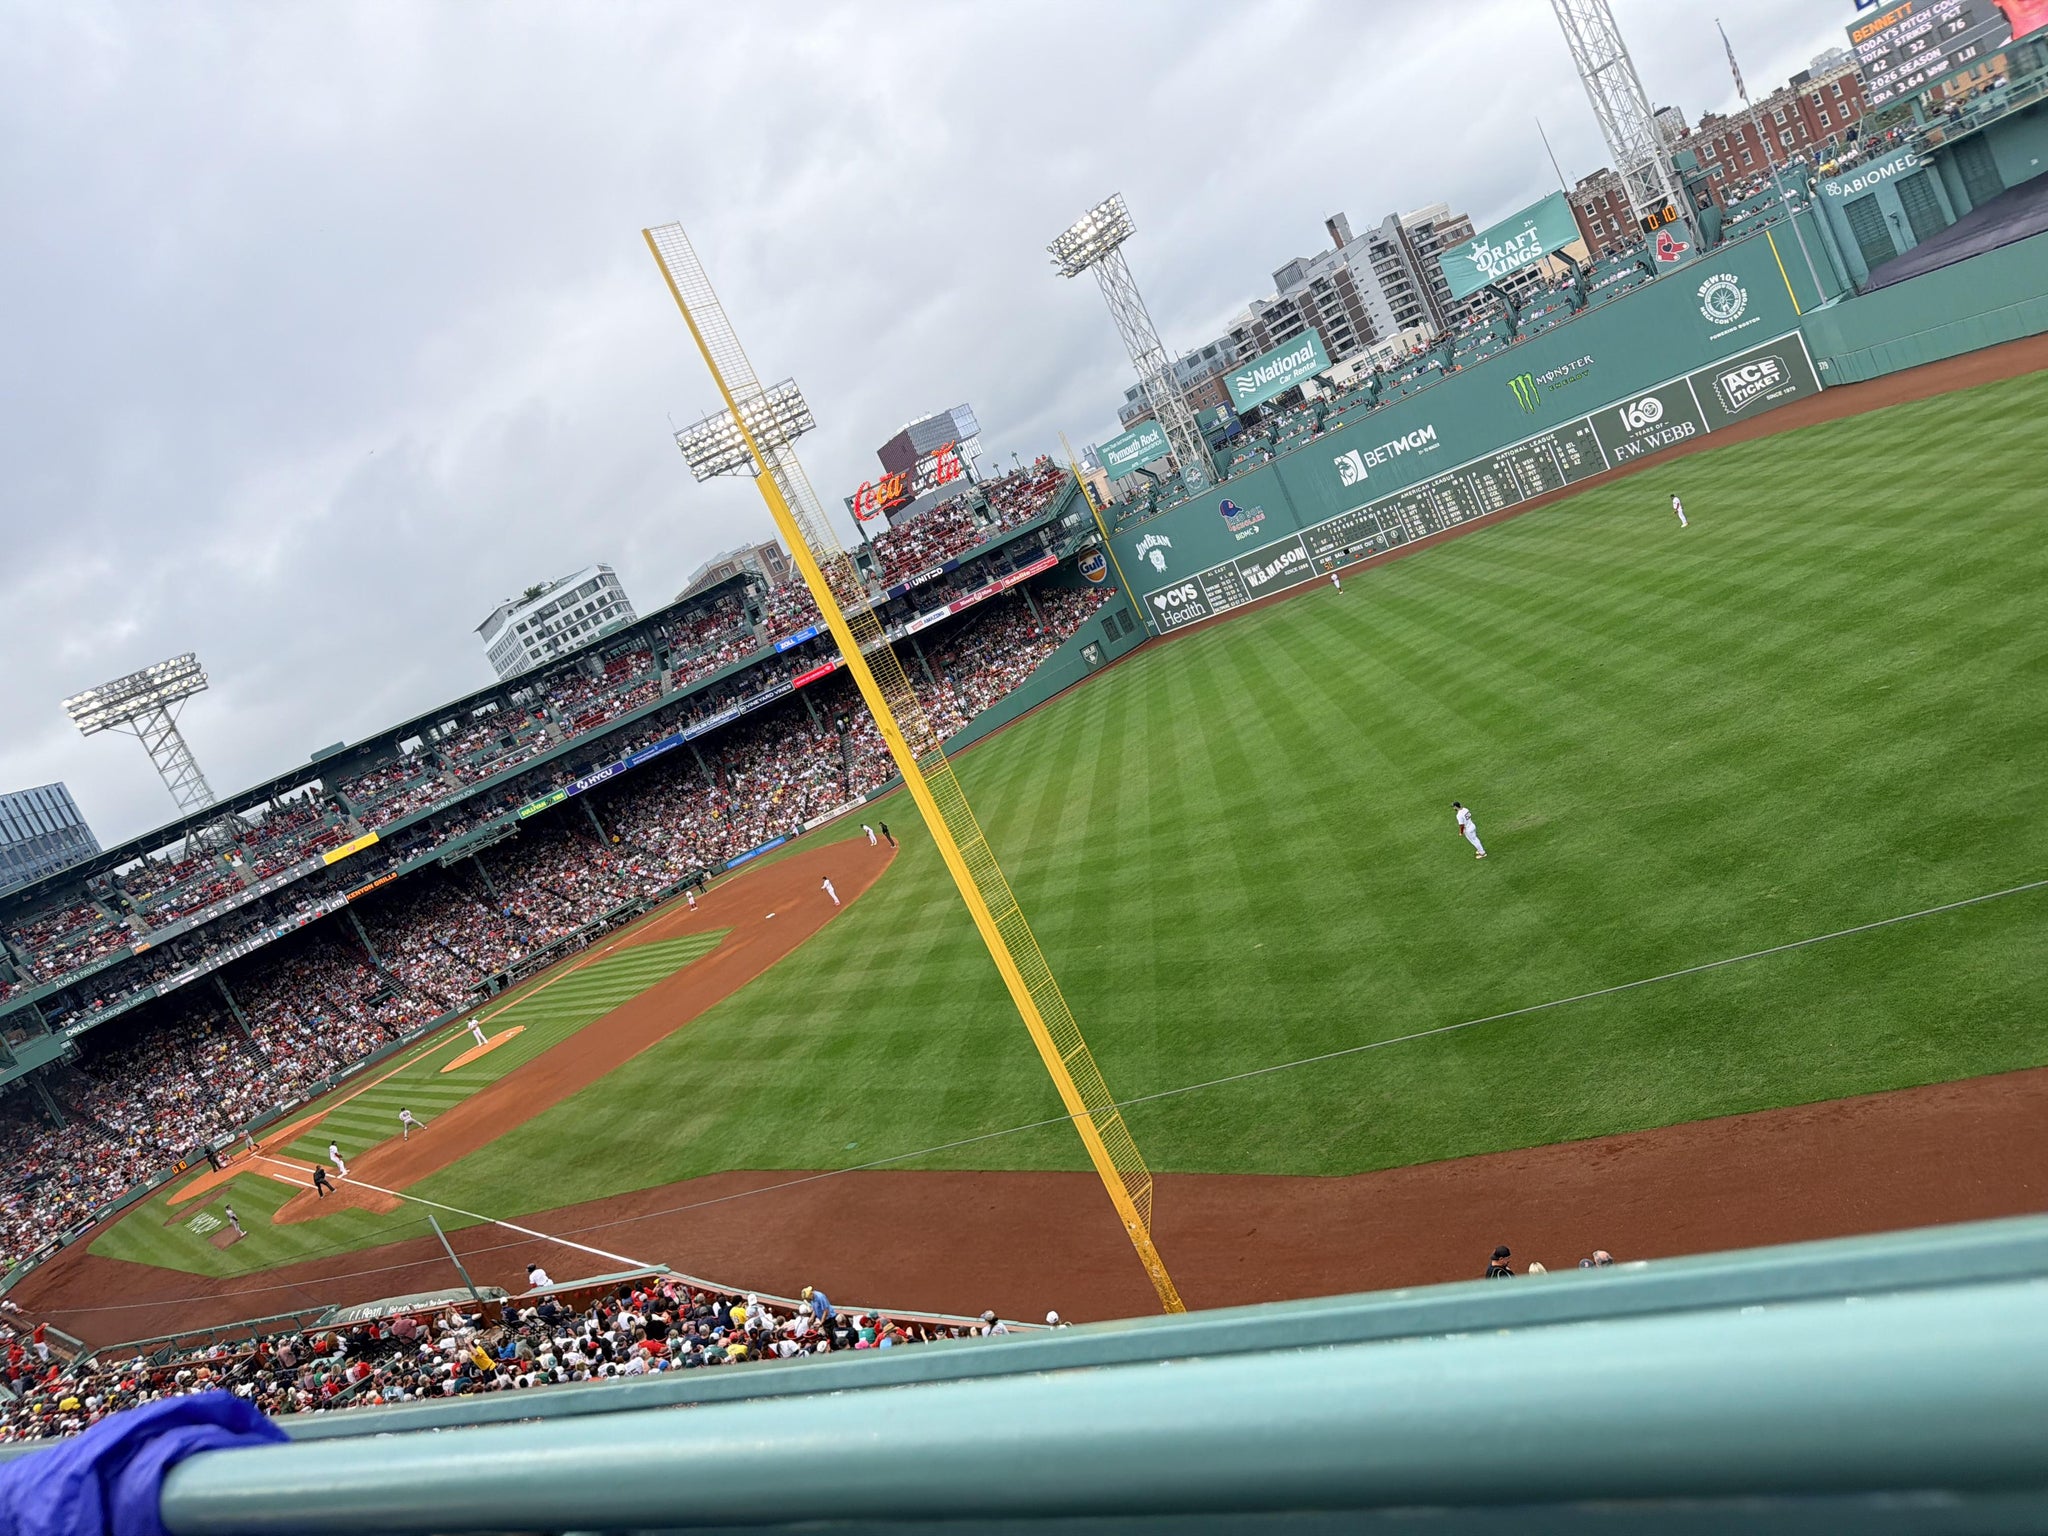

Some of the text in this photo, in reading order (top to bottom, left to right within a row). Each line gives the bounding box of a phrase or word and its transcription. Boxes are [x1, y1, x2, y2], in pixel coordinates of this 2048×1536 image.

[1853, 2, 1912, 43] BENNETT
[1857, 9, 1932, 54] TODAY'S PITCH
[1861, 5, 1961, 63] TOTAL STRIKES PCT
[1873, 19, 1965, 72] 42 32 76
[1871, 49, 1941, 90] 2026 SEASON
[1873, 90, 1894, 104] ERA
[1897, 73, 1924, 92] 3.64
[1926, 60, 1949, 76] WHIP
[1841, 152, 1918, 196] ABIOMED
[1473, 226, 1540, 272] DRAFT
[1486, 241, 1542, 278] KINGS
[1696, 273, 1737, 297] IBEW 103
[1699, 287, 1746, 324] NECA CONTRACTORS
[1278, 359, 1317, 385] Car Rental
[1728, 358, 1777, 391] ACE
[1734, 371, 1781, 402] TICKET
[1766, 390, 1783, 400] SINCE
[1618, 394, 1666, 432] 160
[1613, 420, 1695, 461] F.W. WEBB
[1634, 426, 1653, 437] YEARS
[1107, 428, 1159, 464] Plymouth Rock
[1363, 423, 1436, 468] BETMGM
[1496, 433, 1555, 460] NATIONAL LEAGUE
[1400, 483, 1429, 498] AMERICAN
[1431, 473, 1454, 486] LEAGUE
[1316, 506, 1372, 532] FENWAY PARK
[1235, 527, 1254, 541] BIDMC
[911, 566, 944, 586] UNITED
[1079, 554, 1105, 574] Gulf
[1214, 565, 1226, 574] EAST
[1165, 581, 1198, 607] CVS
[1160, 598, 1206, 627] Health
[779, 637, 795, 649] ZOLL
[587, 768, 613, 784] HYCU
[330, 897, 344, 908] 4TH
[346, 883, 373, 900] KENYON
[78, 958, 111, 977] PAVILION
[127, 993, 146, 1006] Level
